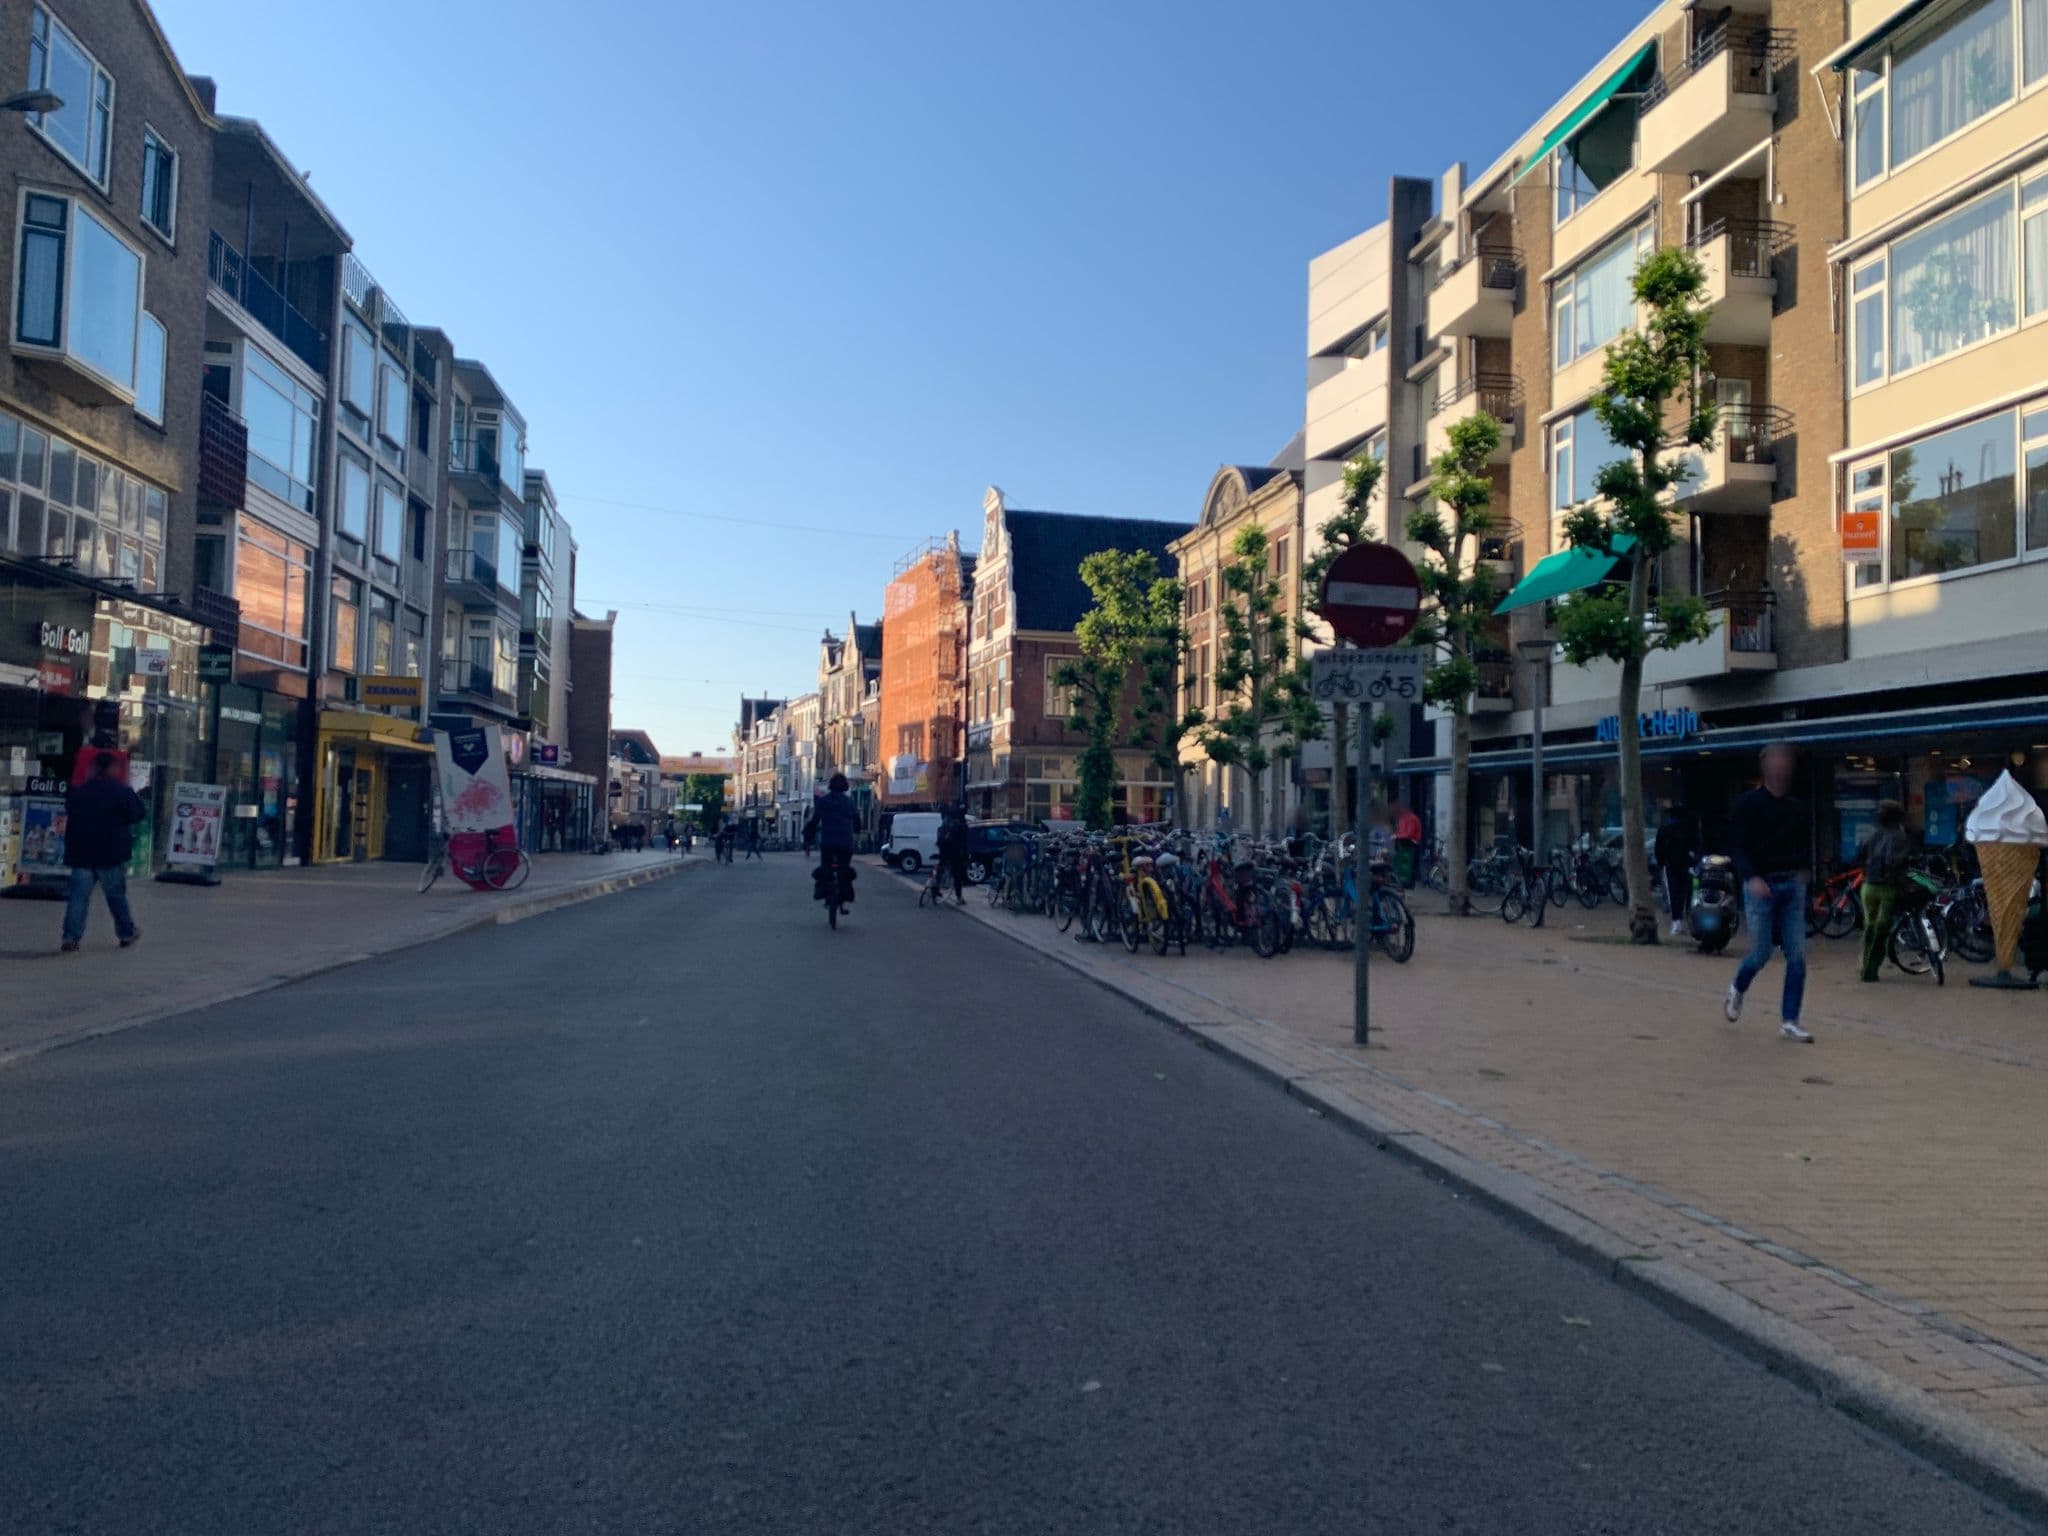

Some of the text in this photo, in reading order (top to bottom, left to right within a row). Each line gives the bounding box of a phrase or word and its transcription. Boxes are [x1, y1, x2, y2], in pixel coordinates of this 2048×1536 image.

[41, 622, 64, 650] Gall
[68, 628, 89, 656] Gall
[1317, 652, 1418, 665] uitgezonderd
[366, 686, 417, 696] ZEEMAN
[1652, 708, 1698, 740] Heijn
[31, 779, 53, 793] Gall
